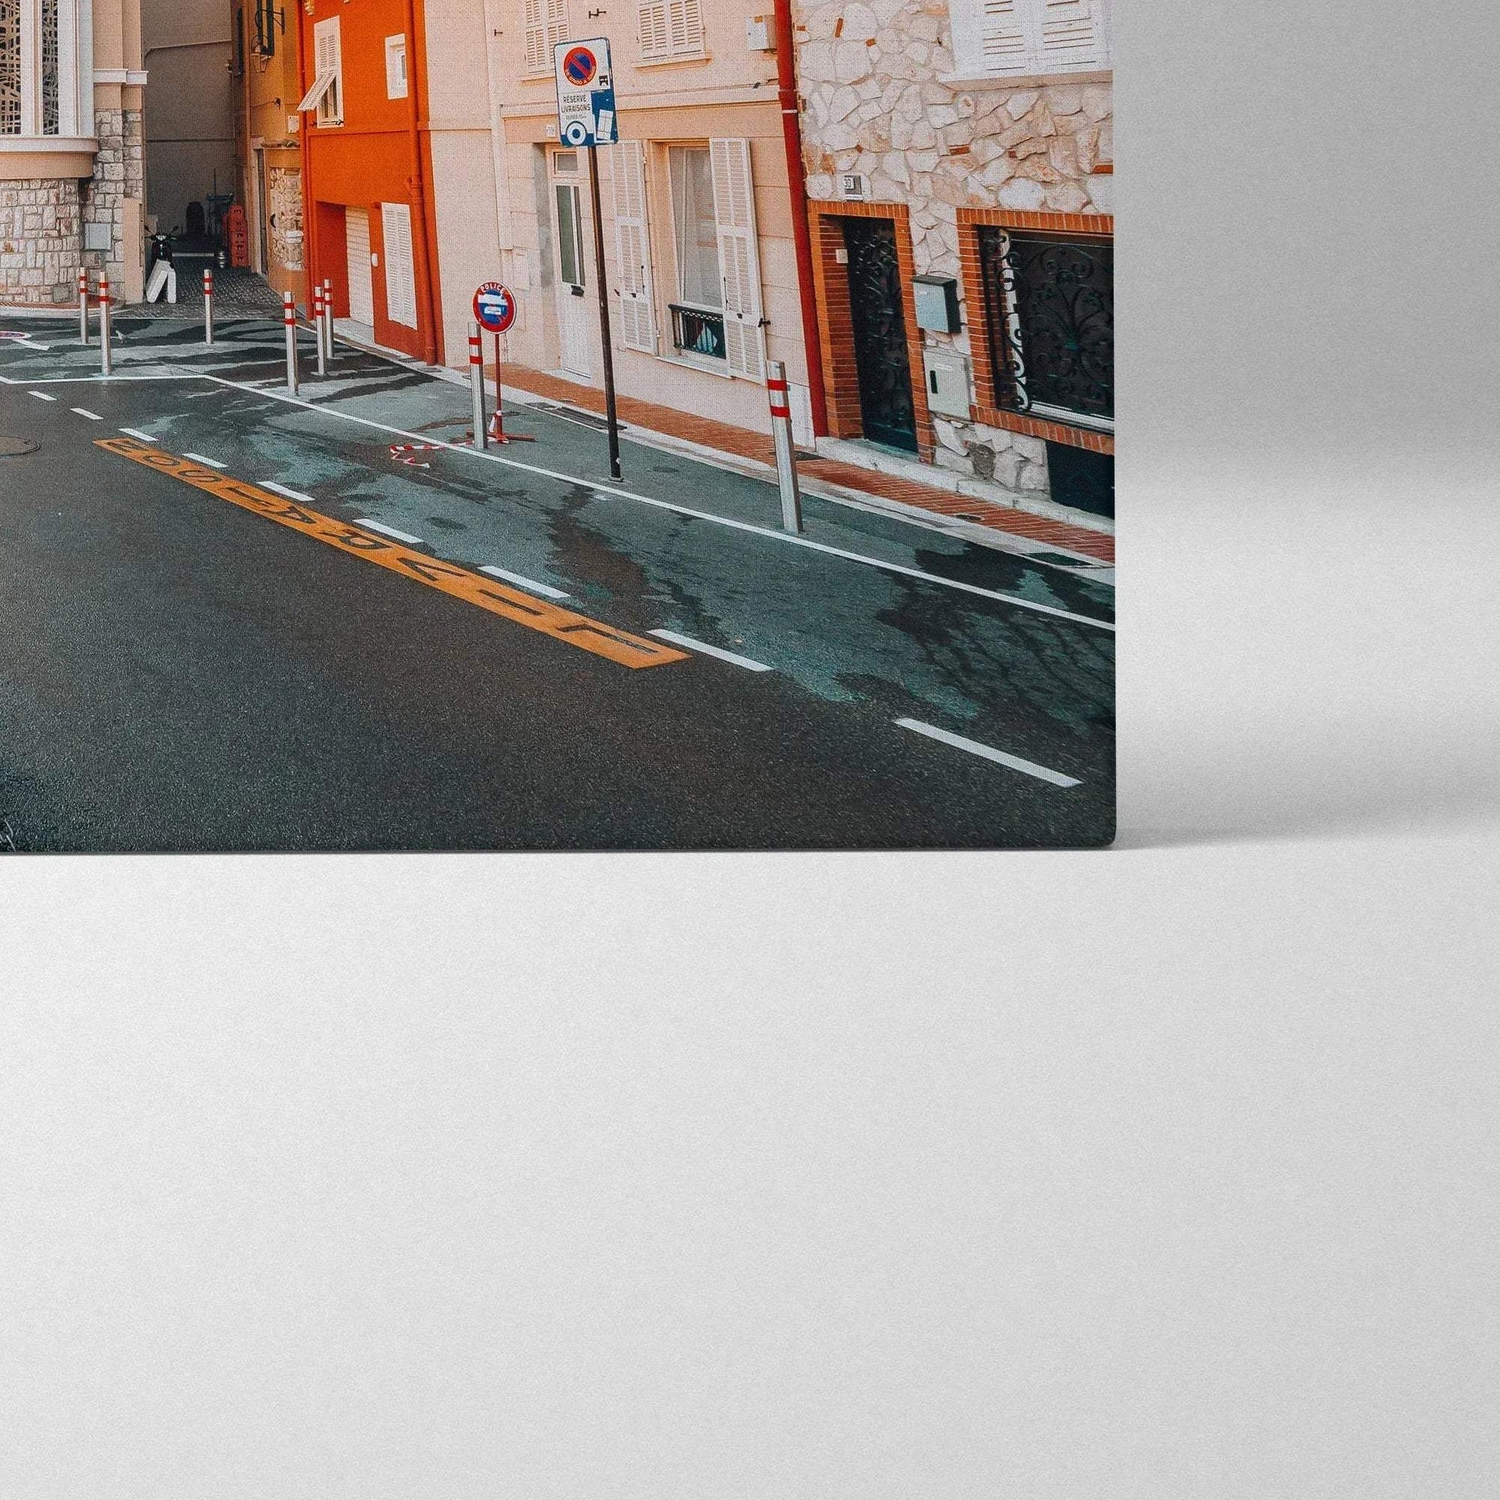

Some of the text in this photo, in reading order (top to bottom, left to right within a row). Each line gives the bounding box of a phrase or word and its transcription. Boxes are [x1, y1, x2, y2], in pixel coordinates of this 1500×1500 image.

[561, 104, 591, 113] LIVRAISONS
[844, 178, 852, 188] 30
[480, 283, 505, 293] POLICE
[104, 440, 660, 655] LIVRAISON
